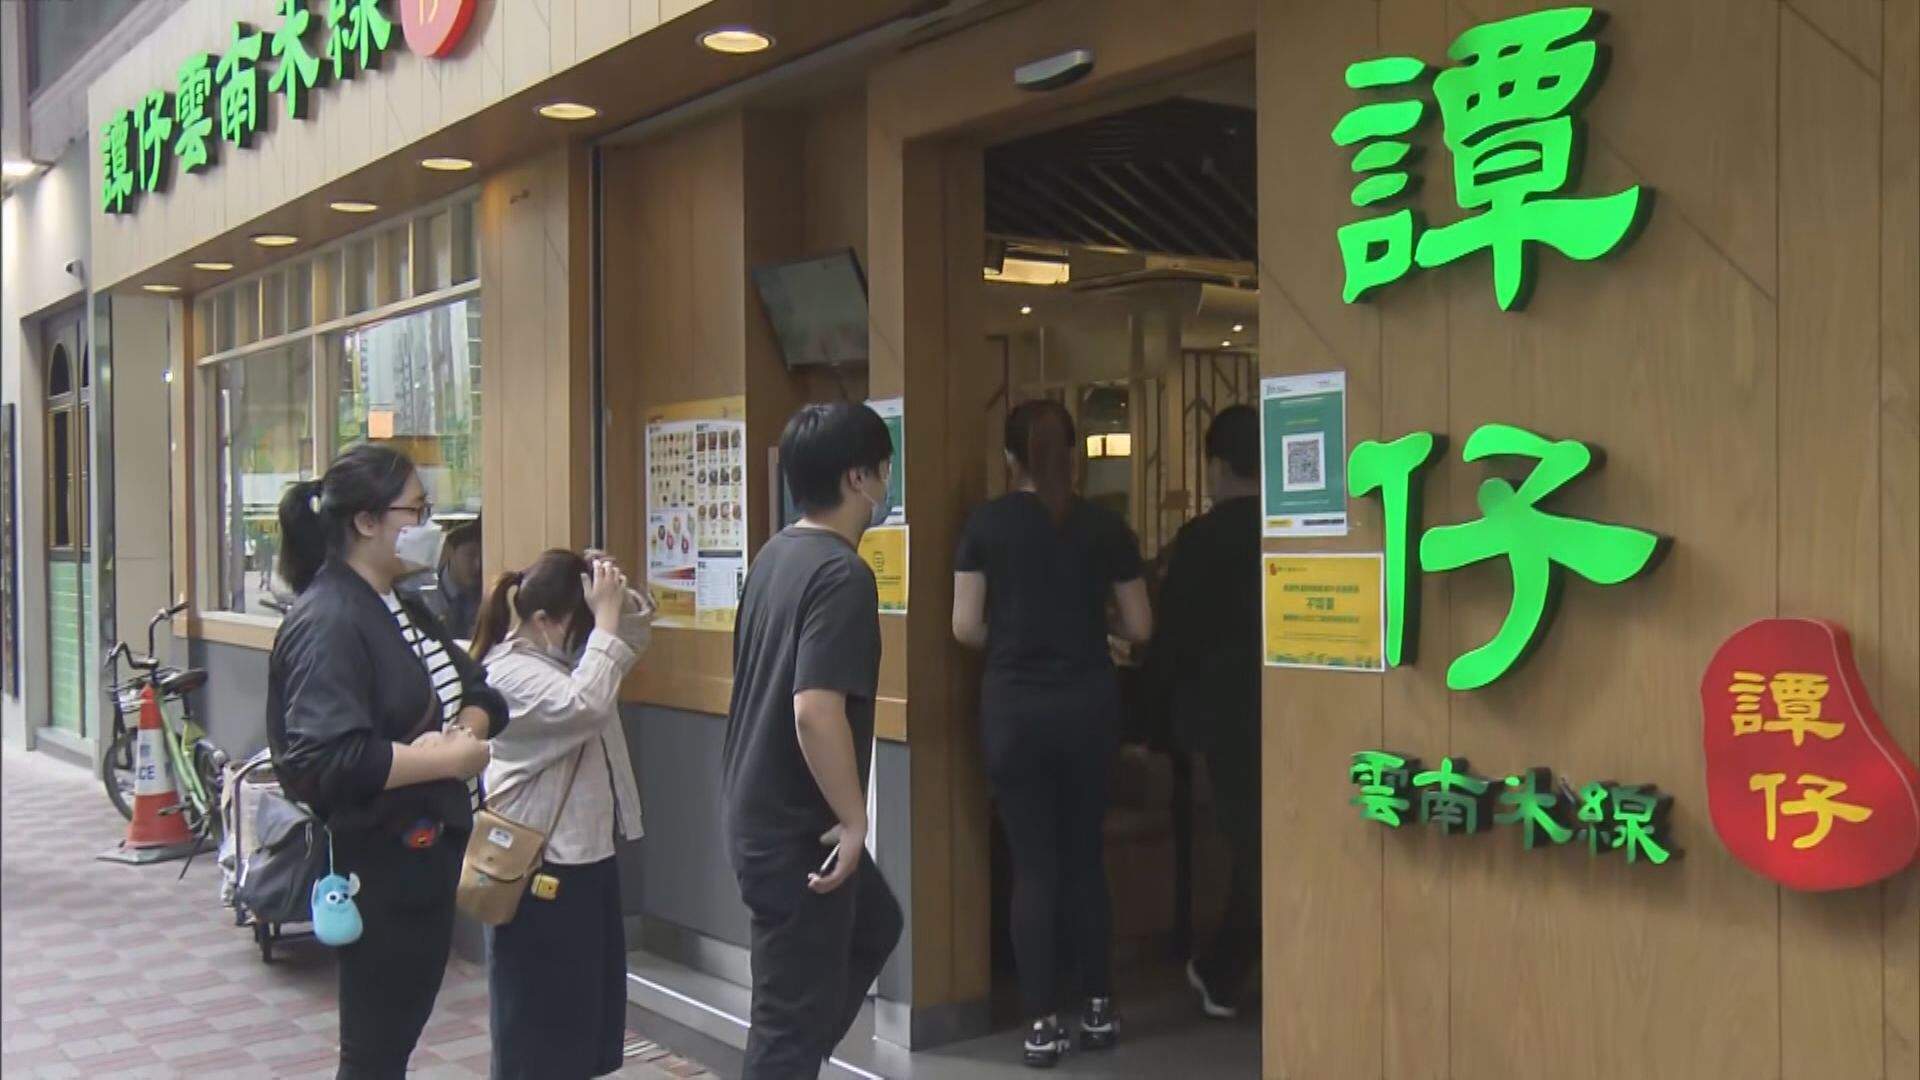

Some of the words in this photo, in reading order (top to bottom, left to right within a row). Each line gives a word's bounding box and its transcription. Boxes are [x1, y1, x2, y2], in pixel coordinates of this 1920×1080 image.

[1331, 6, 1658, 691] 譚仔
[1350, 751, 1671, 866] 雲南米線
[1728, 671, 1873, 849] 譚仔
